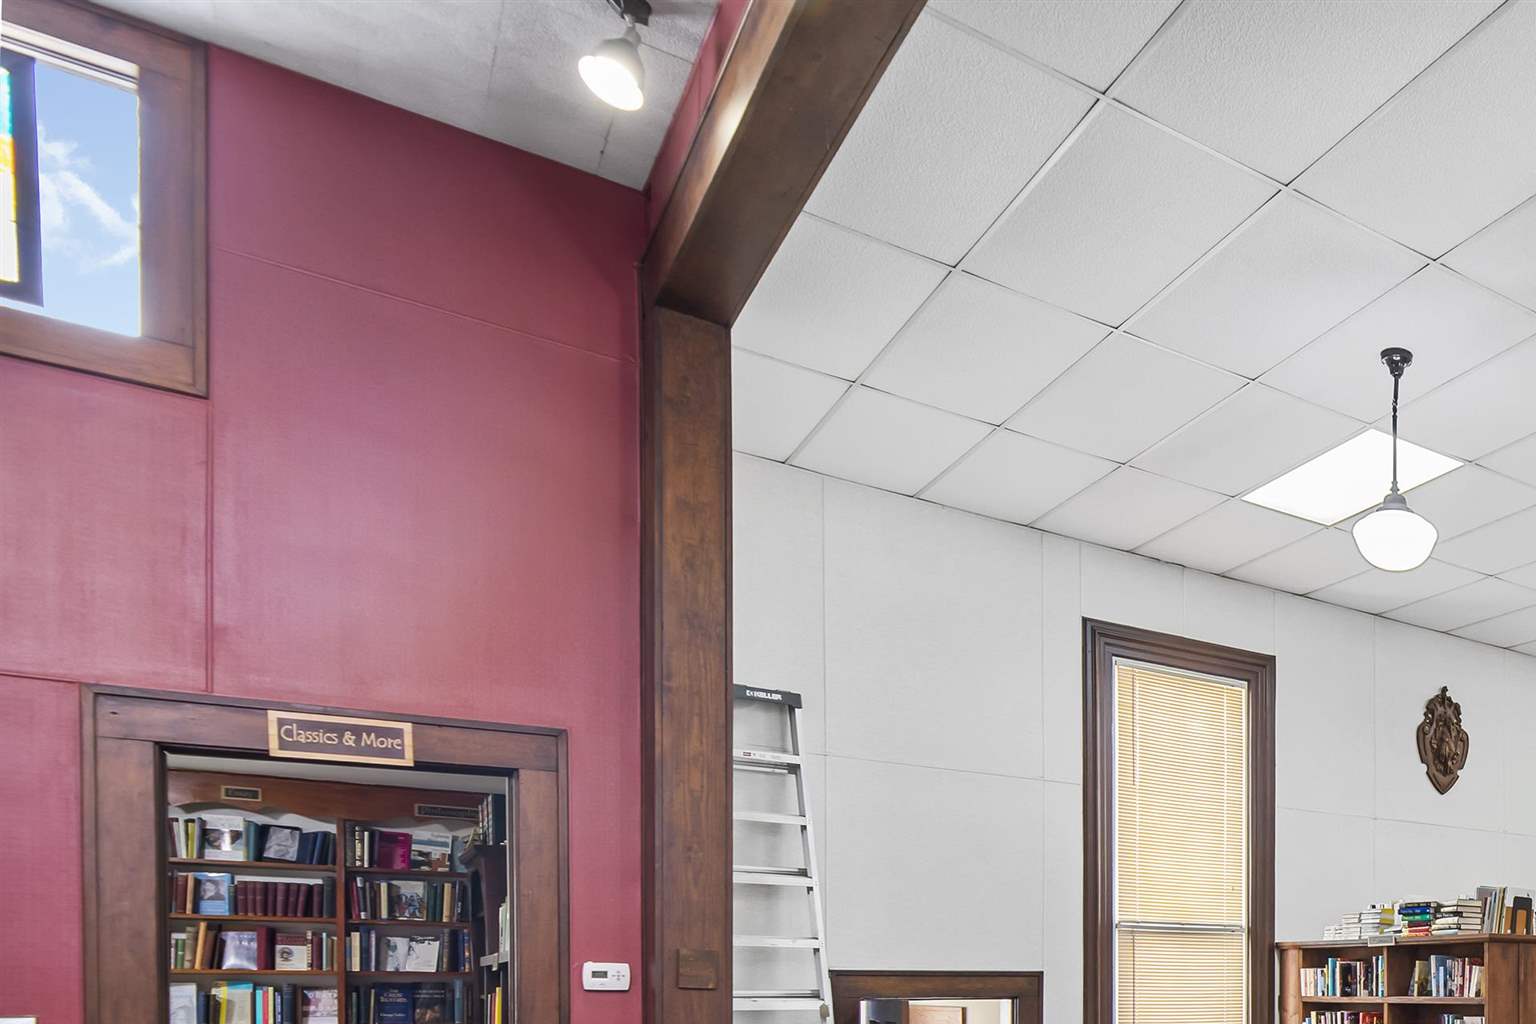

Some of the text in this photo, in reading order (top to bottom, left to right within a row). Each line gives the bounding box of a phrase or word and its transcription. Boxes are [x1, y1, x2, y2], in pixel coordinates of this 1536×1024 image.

[281, 723, 403, 751] Classics & More
